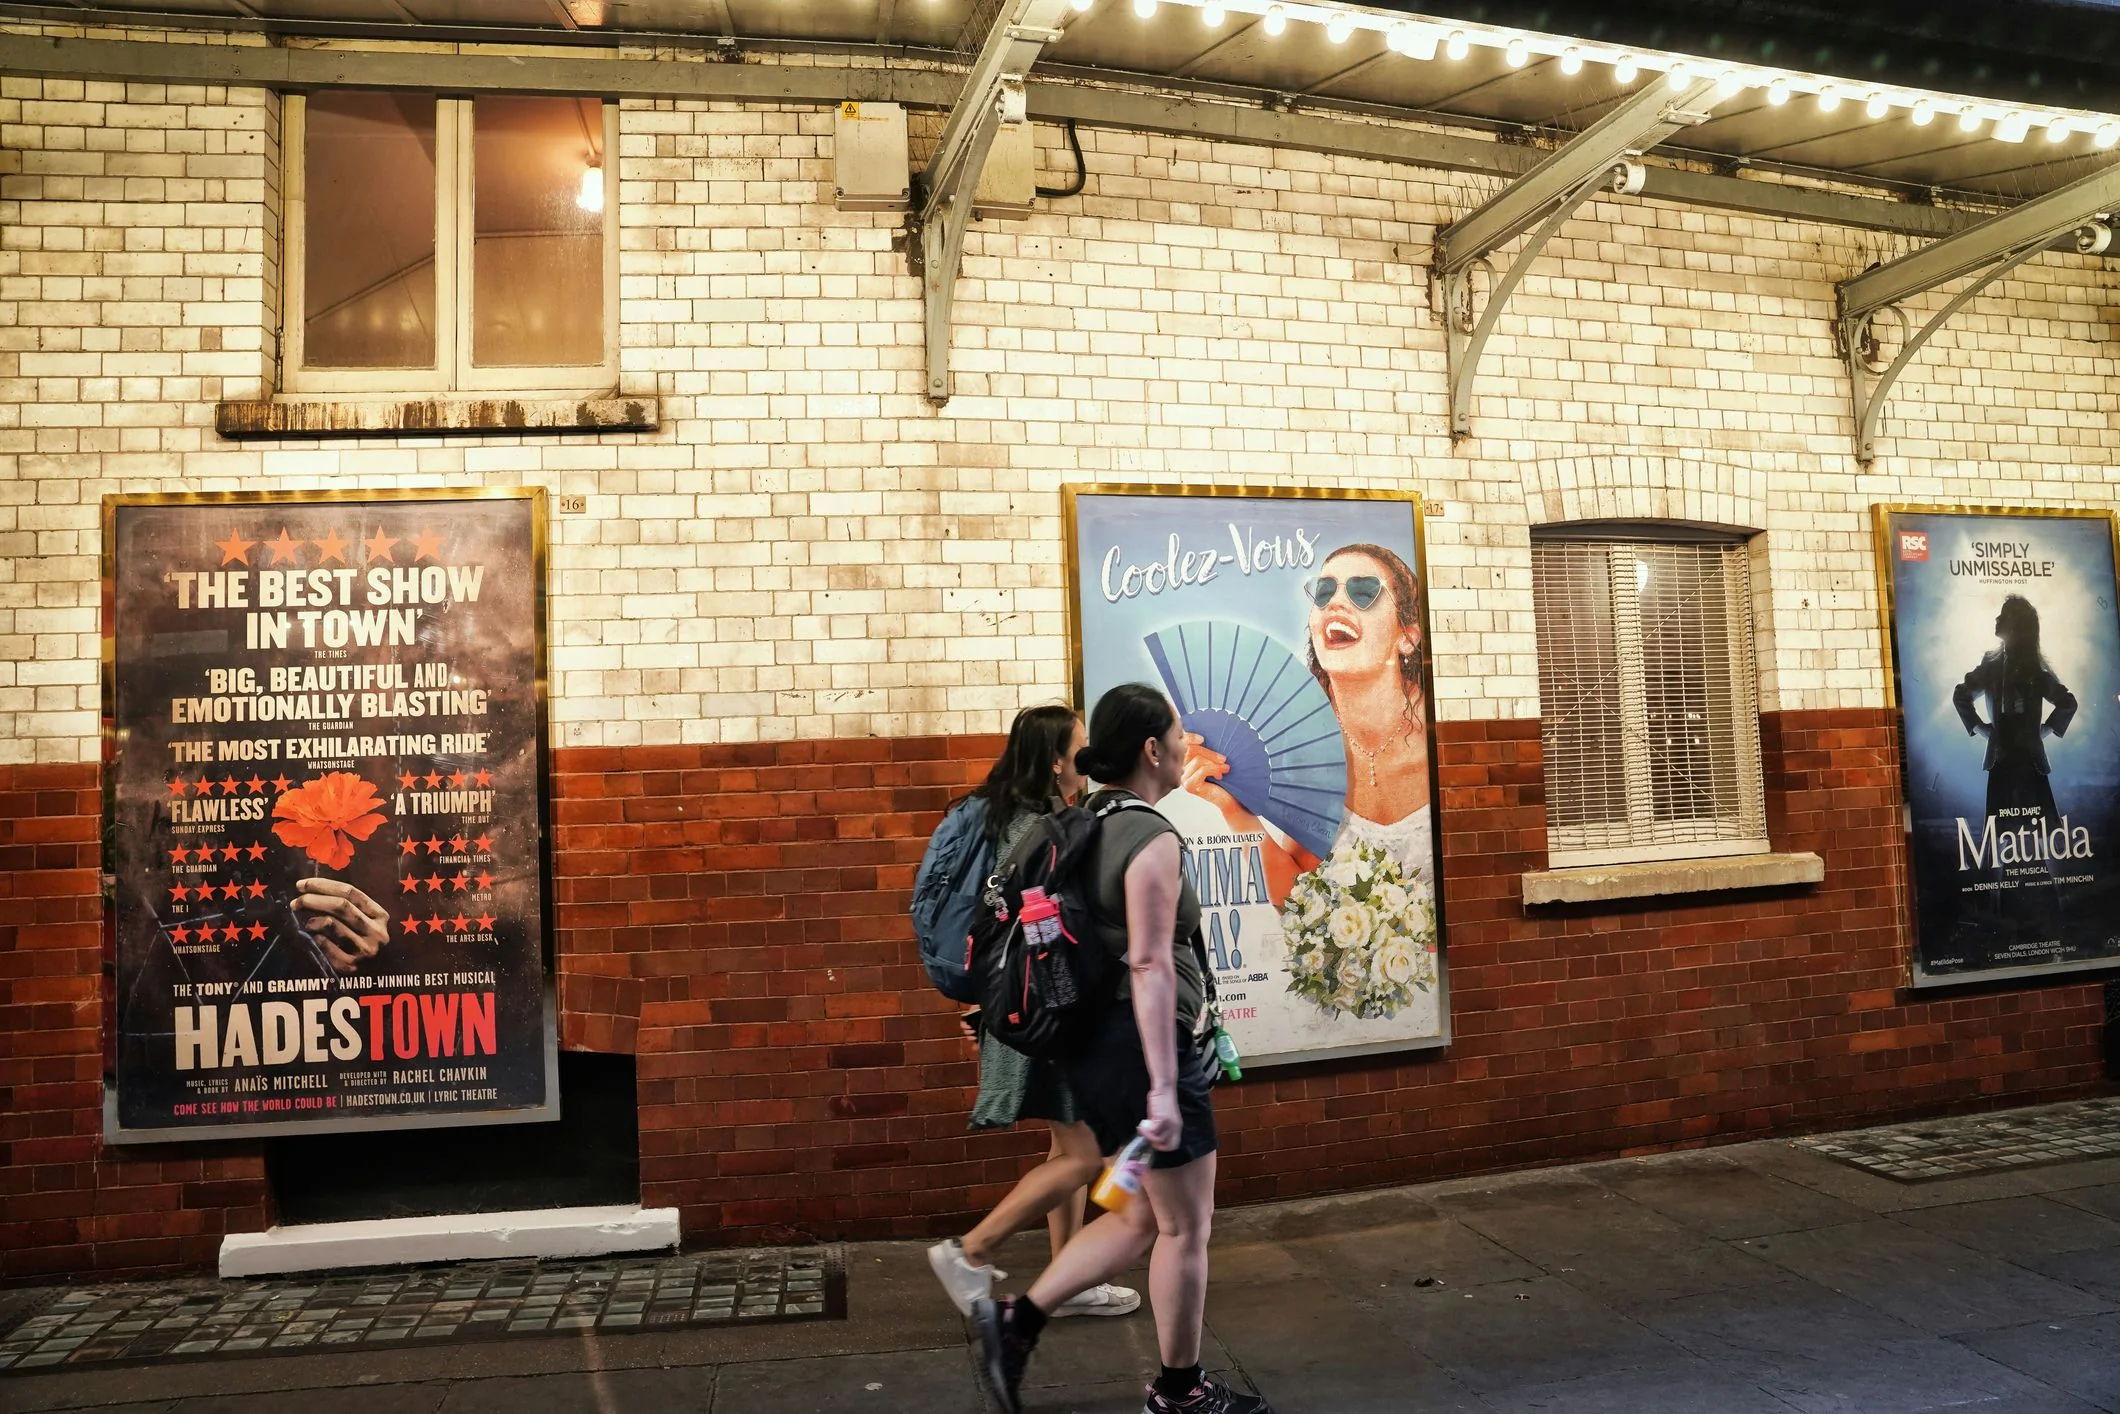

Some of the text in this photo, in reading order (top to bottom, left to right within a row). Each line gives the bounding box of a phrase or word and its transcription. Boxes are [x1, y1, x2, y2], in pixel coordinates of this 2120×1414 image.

[566, 498, 580, 511] 16
[1429, 503, 1440, 513] 17
[1901, 535, 1927, 551] RSC
[1100, 522, 1321, 603] Coolez-Vous
[259, 567, 358, 607] BEST
[366, 565, 485, 606] SHOW
[246, 611, 287, 650] IN
[314, 650, 347, 659] THE TIMES
[269, 663, 409, 693] BEAUTIFUL
[413, 662, 448, 689] AND
[171, 692, 356, 724] EMOTIONALLY
[308, 720, 354, 731] THE GUARDIAN
[218, 738, 282, 762] MOST
[286, 733, 437, 760] EXHILARATING
[307, 759, 355, 770] WHATSONSTAGE
[1999, 807, 2020, 818] ROALD
[461, 815, 490, 824] TIME OUT
[171, 824, 226, 835] SUNDAY EXPRESS
[1196, 836, 1204, 846] &
[1955, 814, 2095, 871] Matilda
[439, 854, 491, 865] FINANCIAL TIMES
[172, 863, 217, 874] THE GUARDIAN
[2005, 865, 2049, 877] THE MUSICAL
[1181, 845, 1270, 908] MMA
[2053, 876, 2066, 885] TIM
[2066, 874, 2094, 884] MINCHIN
[1974, 881, 1999, 892] DENNIS
[1999, 880, 2020, 889] KELLY
[471, 893, 492, 902] METRO
[172, 904, 184, 914] THE
[446, 933, 493, 943] THE ARTS DESK
[173, 944, 221, 955] WHATSONSTAGE
[2008, 940, 2061, 952] CAMBRIDGE THEATRE
[1994, 952, 2012, 960] SEVEN
[2027, 948, 2050, 957] LONDON
[173, 983, 193, 998] THE
[243, 981, 263, 994] AND
[339, 973, 421, 990] AWARD-WINNING
[424, 972, 449, 986] BEST
[453, 970, 496, 986] MUSICAL
[1221, 1006, 1258, 1021] EATRE
[174, 991, 497, 1070] HADESTOWN
[339, 1070, 387, 1080] DEVELOPED WITH
[393, 1066, 487, 1085] RACHEL CHAVKIN
[207, 1078, 229, 1087] LYRICS
[234, 1074, 328, 1092] ANAÏS MITCHELL
[350, 1078, 378, 1087] DIRECTED
[173, 1088, 498, 1116] COME SEE HOW THE WORLD COULD BE HADESTOWN.CO.UK LYRIC THEATRE
